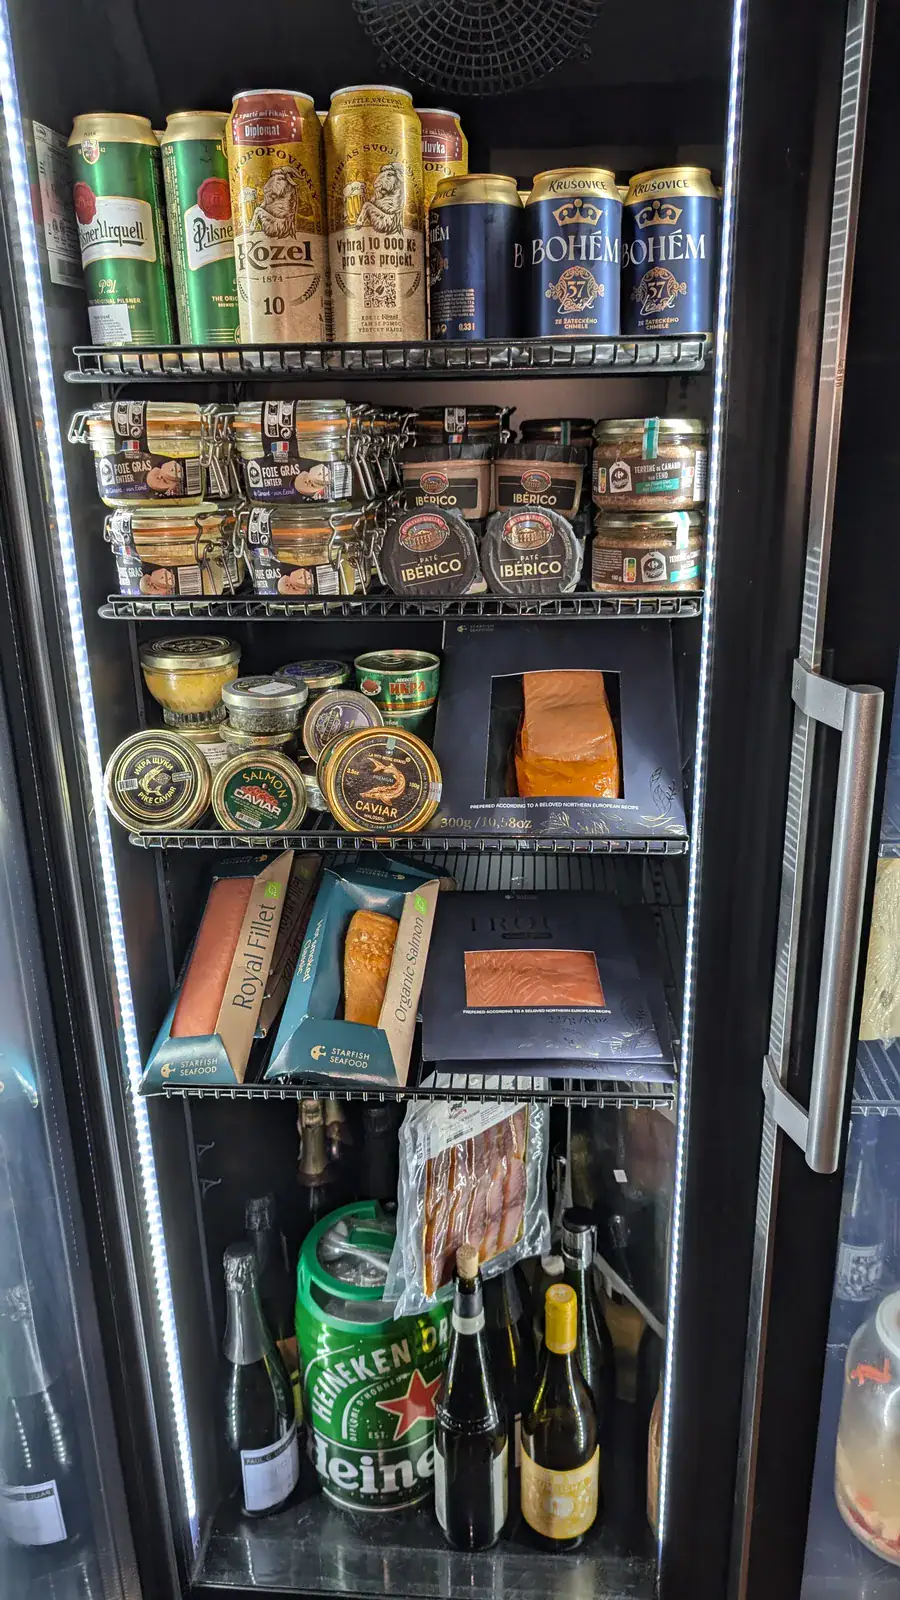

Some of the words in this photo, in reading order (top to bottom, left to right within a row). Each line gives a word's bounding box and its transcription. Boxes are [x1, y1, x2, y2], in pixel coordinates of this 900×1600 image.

[245, 123, 280, 138] Diplomat
[422, 141, 446, 154] luvka
[548, 179, 607, 193] KRUŠOVICE
[632, 179, 690, 197] KRUŠOVICE
[193, 217, 233, 252] Pilsne
[336, 238, 365, 254] Vyhraj
[369, 237, 380, 250] 10
[384, 237, 404, 251] 000
[406, 239, 416, 252] Kč
[532, 230, 619, 265] BOHÉM
[623, 229, 706, 268] BOHÉM
[237, 240, 314, 271] Kozel
[342, 255, 356, 269] pro
[359, 252, 375, 267] váš
[380, 252, 415, 267] projekt.
[567, 281, 587, 298] 37
[647, 280, 666, 298] 37
[263, 296, 285, 315] 10
[557, 295, 595, 316] Ležák
[639, 296, 675, 316] Ležák
[564, 316, 598, 325] ŽATECKÉHO
[645, 317, 679, 325] ŽATECKÉHO
[114, 463, 130, 475] FOIE
[131, 459, 152, 473] GRAS
[262, 466, 279, 478] FOIE
[280, 464, 301, 476] GRAS
[633, 464, 656, 474] TERRINE
[661, 461, 681, 471] CANARD
[115, 474, 135, 485] ENTIER
[264, 477, 283, 487] ENTIER
[415, 494, 457, 507] IBÉRICO
[513, 493, 557, 506] IBÉRICO
[420, 554, 438, 564] PATÉ
[520, 553, 539, 562] PATÉ
[265, 568, 281, 579] GRAS
[401, 558, 462, 582] IBÉRICO
[500, 561, 562, 578] IBÉRICO
[389, 680, 426, 695] ИКРА
[133, 758, 152, 775] ИКРА
[152, 757, 174, 771] ЩУКИ
[242, 771, 288, 799] SALMON
[138, 791, 154, 804] PIKE
[154, 786, 176, 804] CAVIAR
[233, 788, 282, 816] CAVIAR
[355, 800, 398, 818] CAVIAR
[440, 818, 472, 830] 300g
[246, 903, 277, 951] Fillet
[394, 966, 416, 1023] Organic
[406, 916, 425, 966] Salmon
[232, 953, 265, 1010] Royal
[329, 1055, 368, 1069] SEAFOOD
[331, 1047, 370, 1061] STARFISH
[180, 1058, 218, 1068] STARFISH
[180, 1065, 217, 1076] SEAFOOD
[311, 1339, 411, 1425] HEINEKEN
[349, 1407, 361, 1442] DIPLOME
[368, 1431, 389, 1439] EST.
